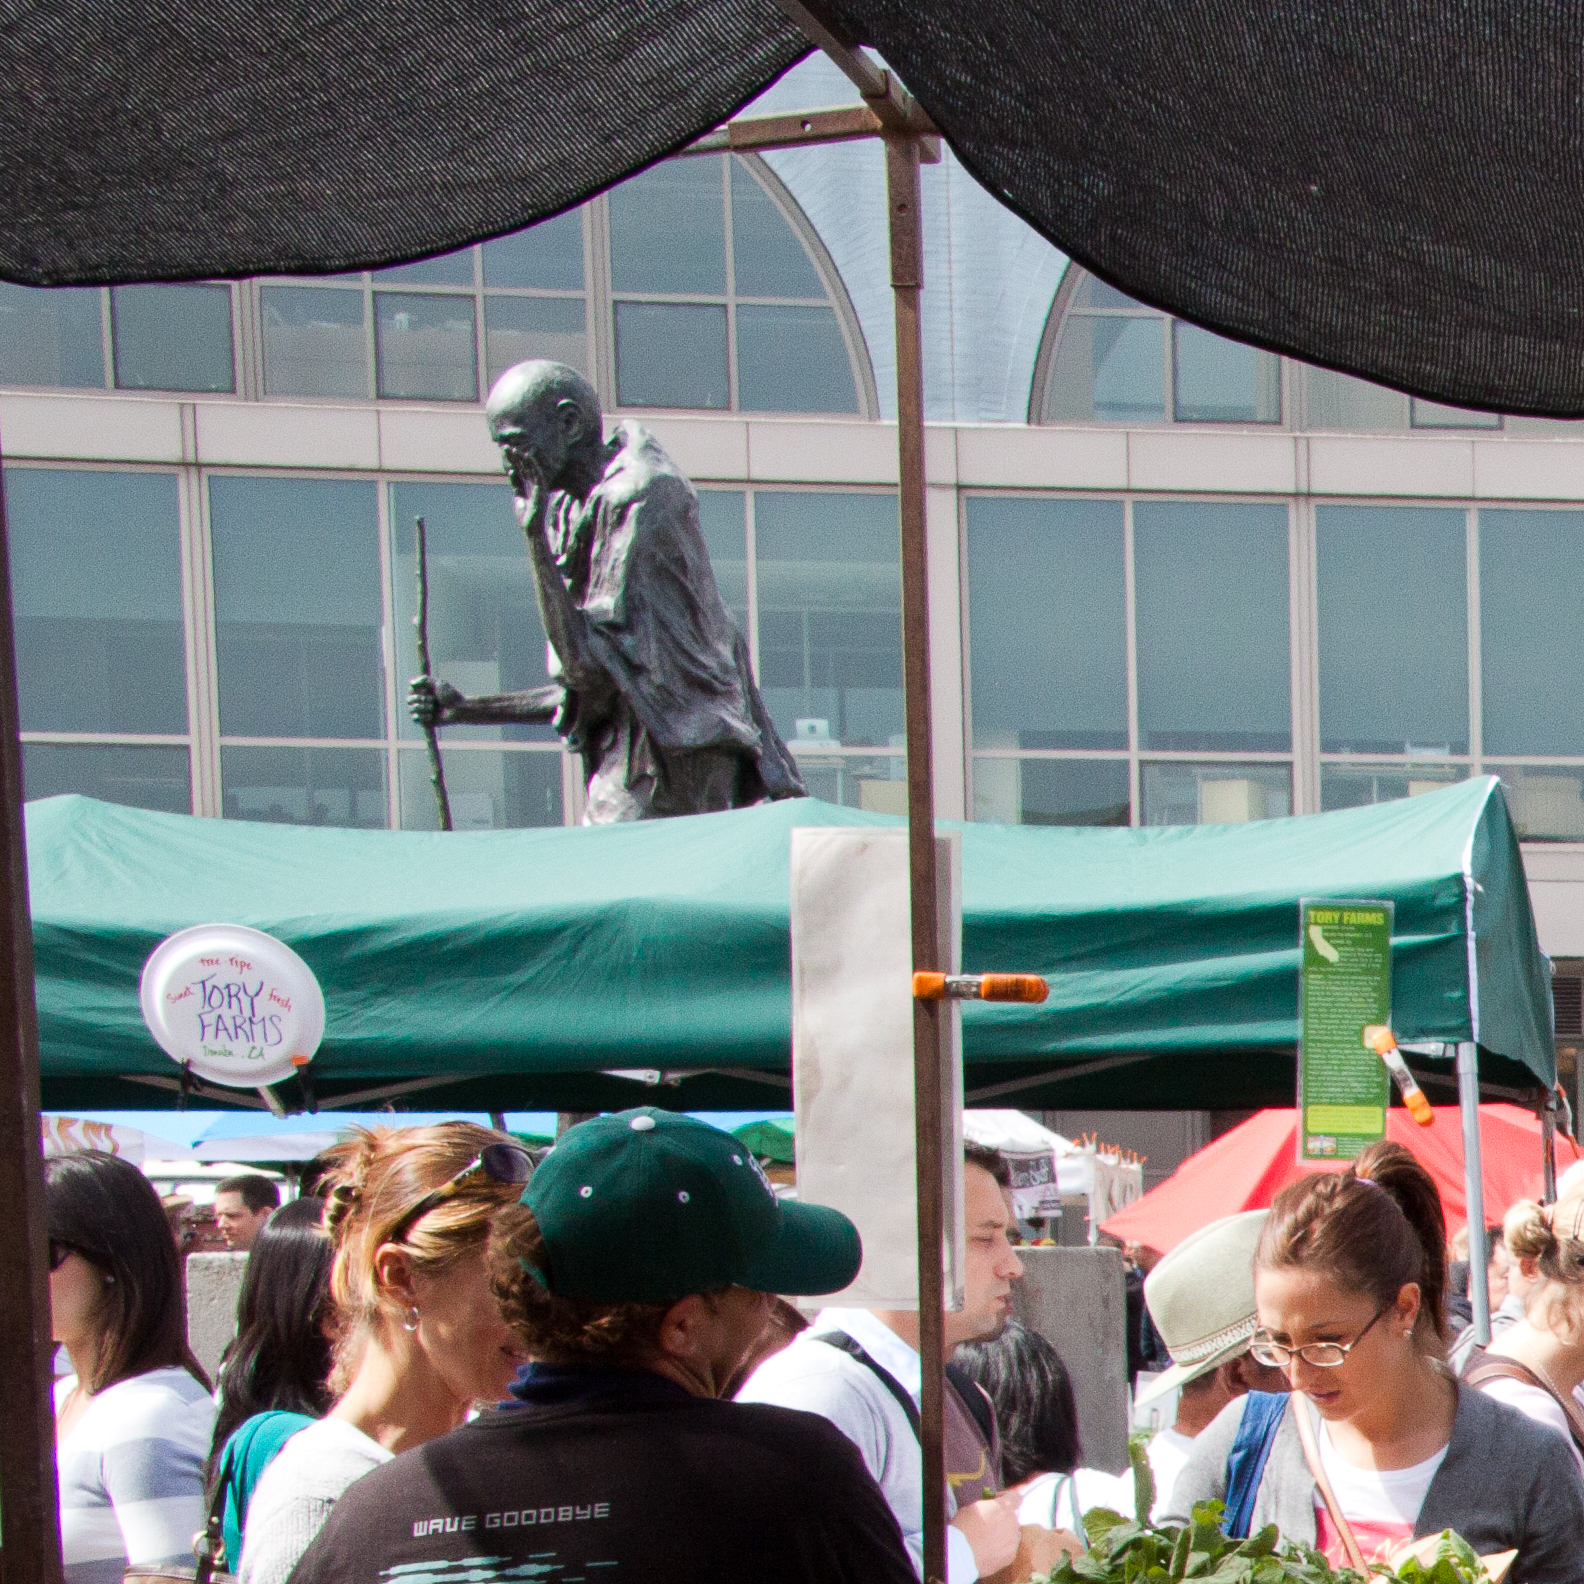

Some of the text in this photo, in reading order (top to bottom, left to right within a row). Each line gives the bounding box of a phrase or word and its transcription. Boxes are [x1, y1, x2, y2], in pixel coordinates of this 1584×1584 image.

[1308, 909, 1385, 926] TORY FARMS
[191, 972, 265, 1018] TORY
[198, 1007, 284, 1047] FARMS
[411, 1502, 612, 1538] WAVE GOODBYE
